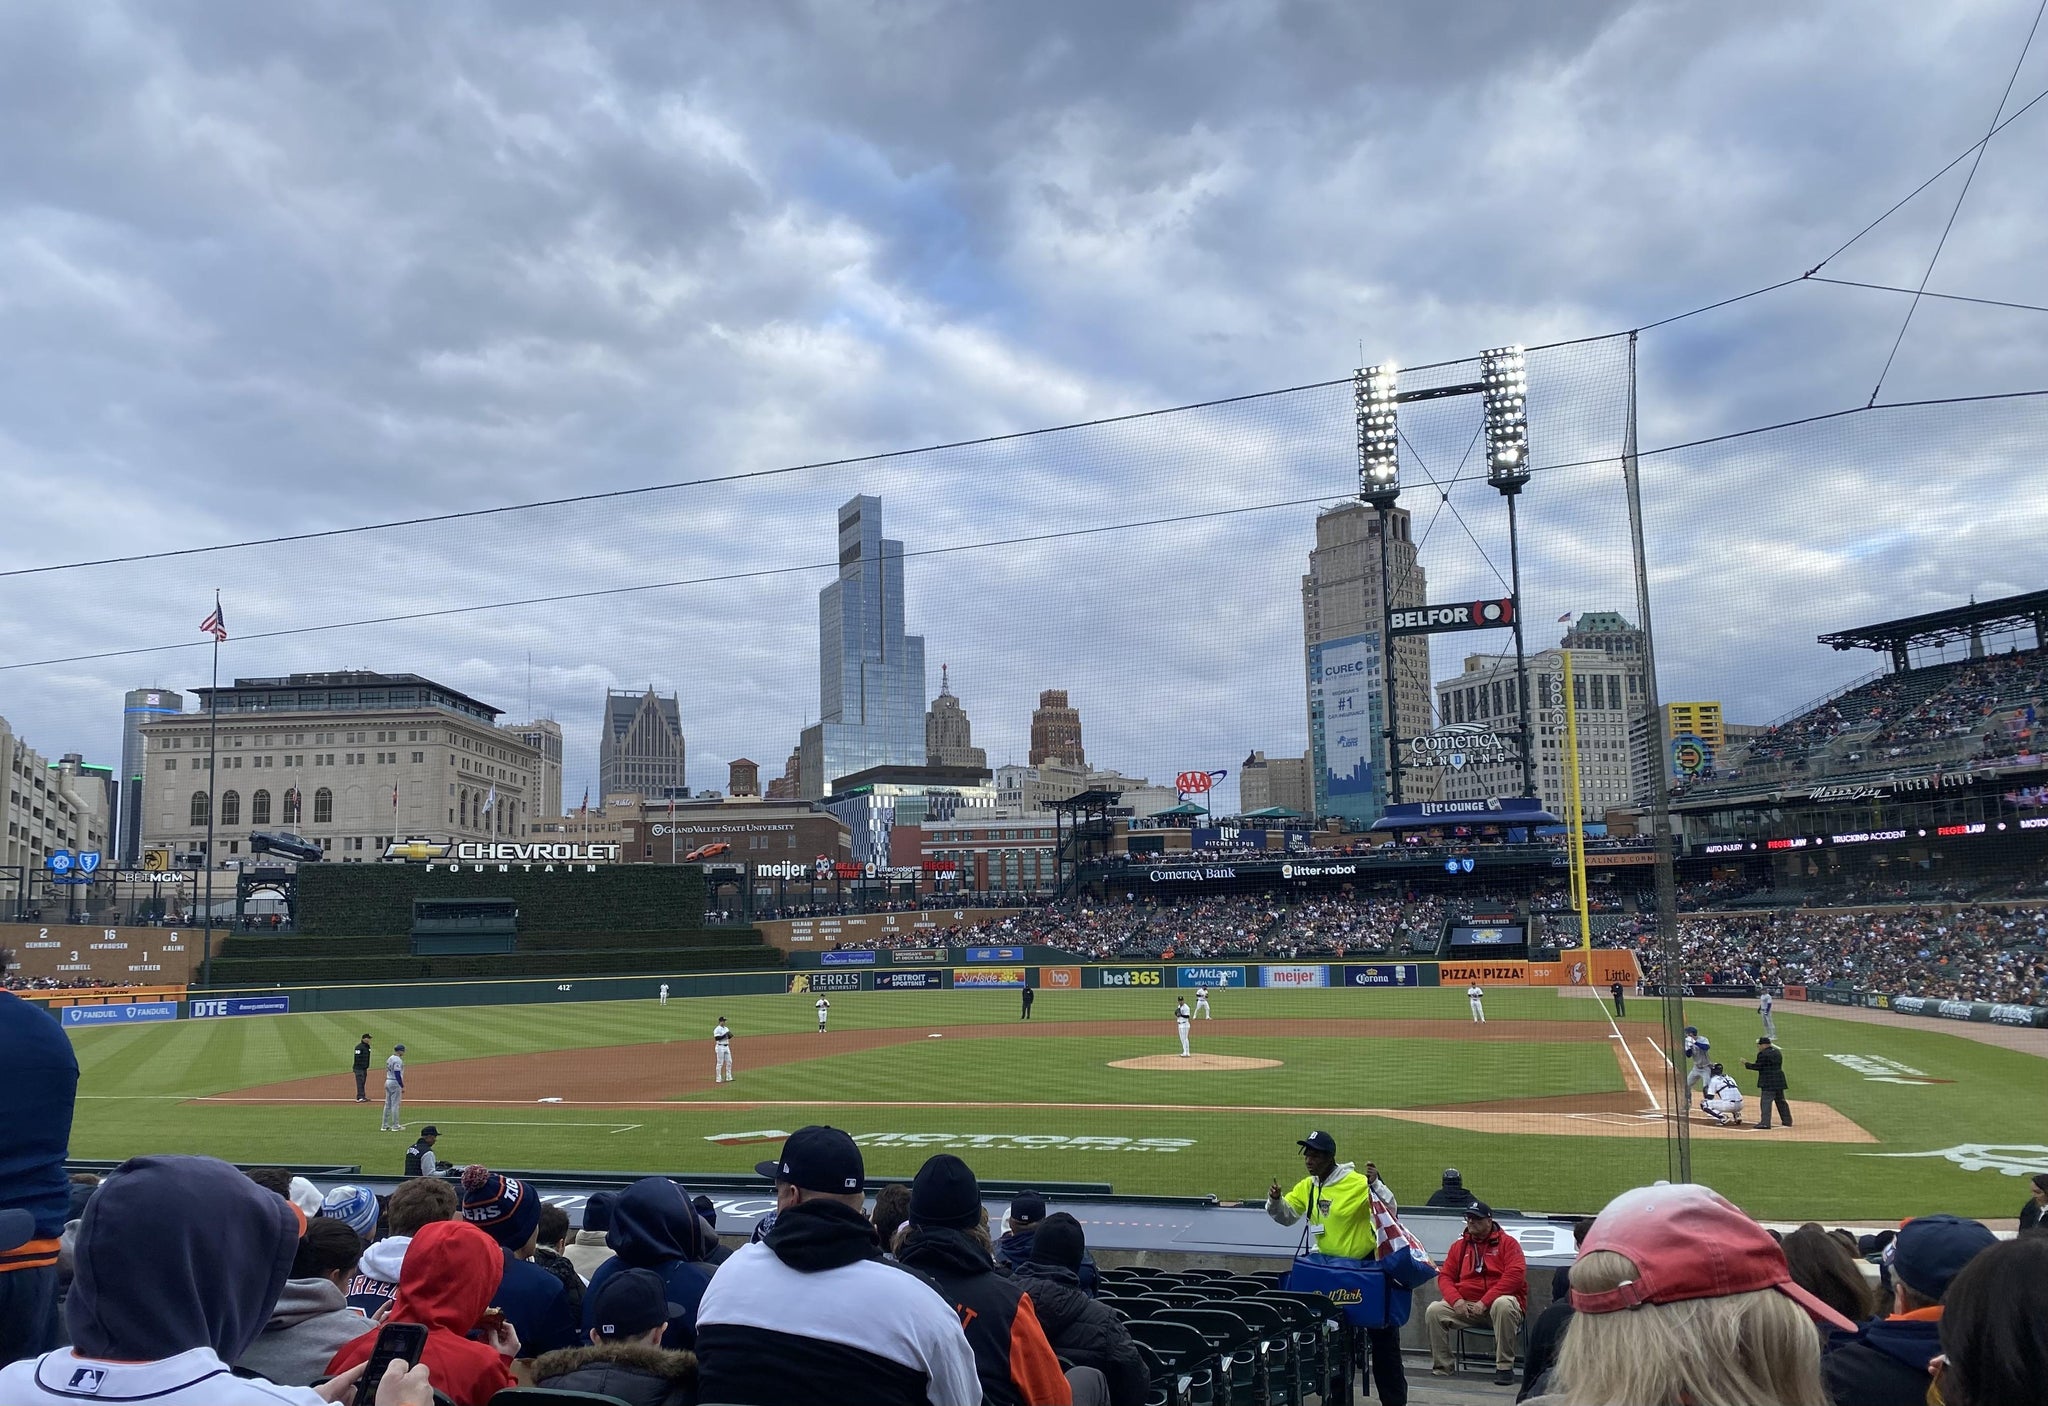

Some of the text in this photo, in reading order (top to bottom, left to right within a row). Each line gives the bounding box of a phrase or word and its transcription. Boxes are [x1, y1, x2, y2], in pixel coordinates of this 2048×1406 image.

[1391, 607, 1468, 629] BELFOR
[1326, 664, 1354, 676] CURE
[1338, 697, 1352, 710] #1
[1550, 671, 1568, 732] Rocket
[1413, 754, 1505, 767] LANDING
[1177, 772, 1211, 792] AAA
[1893, 774, 1974, 792] TIGER CLUB
[1422, 802, 1484, 816] Lite LOUNGE
[692, 825, 722, 833] VALLEY
[722, 824, 746, 832] STATE
[746, 824, 794, 832] UNIVERSITY
[1220, 826, 1240, 841] Lite
[1832, 830, 1907, 843] TRUCKING ACCIDENT
[458, 843, 620, 860] CHEVROLET
[1706, 844, 1743, 854] AUTO INJURY
[426, 864, 596, 872] FOUNTAIN
[758, 861, 806, 880] meijer
[923, 861, 956, 870] FIEGER
[126, 872, 183, 882] BETMGM
[838, 870, 860, 878] TIRE
[935, 870, 956, 880] LAW
[1206, 868, 1236, 879] Bank
[886, 916, 894, 924] 10
[922, 913, 928, 921] 11
[954, 912, 964, 920] 42
[40, 928, 48, 938] 2
[104, 930, 116, 940] 16
[170, 932, 178, 942] 6
[70, 951, 78, 962] 3
[142, 952, 148, 962] 1
[812, 974, 858, 986] FERRIS
[960, 971, 998, 983] Surfside
[1052, 971, 1069, 984] hap
[1103, 971, 1160, 985] bet365
[1274, 969, 1314, 984] meijer
[1356, 973, 1389, 984] Corona
[1442, 968, 1524, 980] PIZZA! PIZZA!
[1604, 968, 1630, 982] Little
[83, 1008, 170, 1018] FANDUEL FANDUEL
[194, 1001, 228, 1016] DTE
